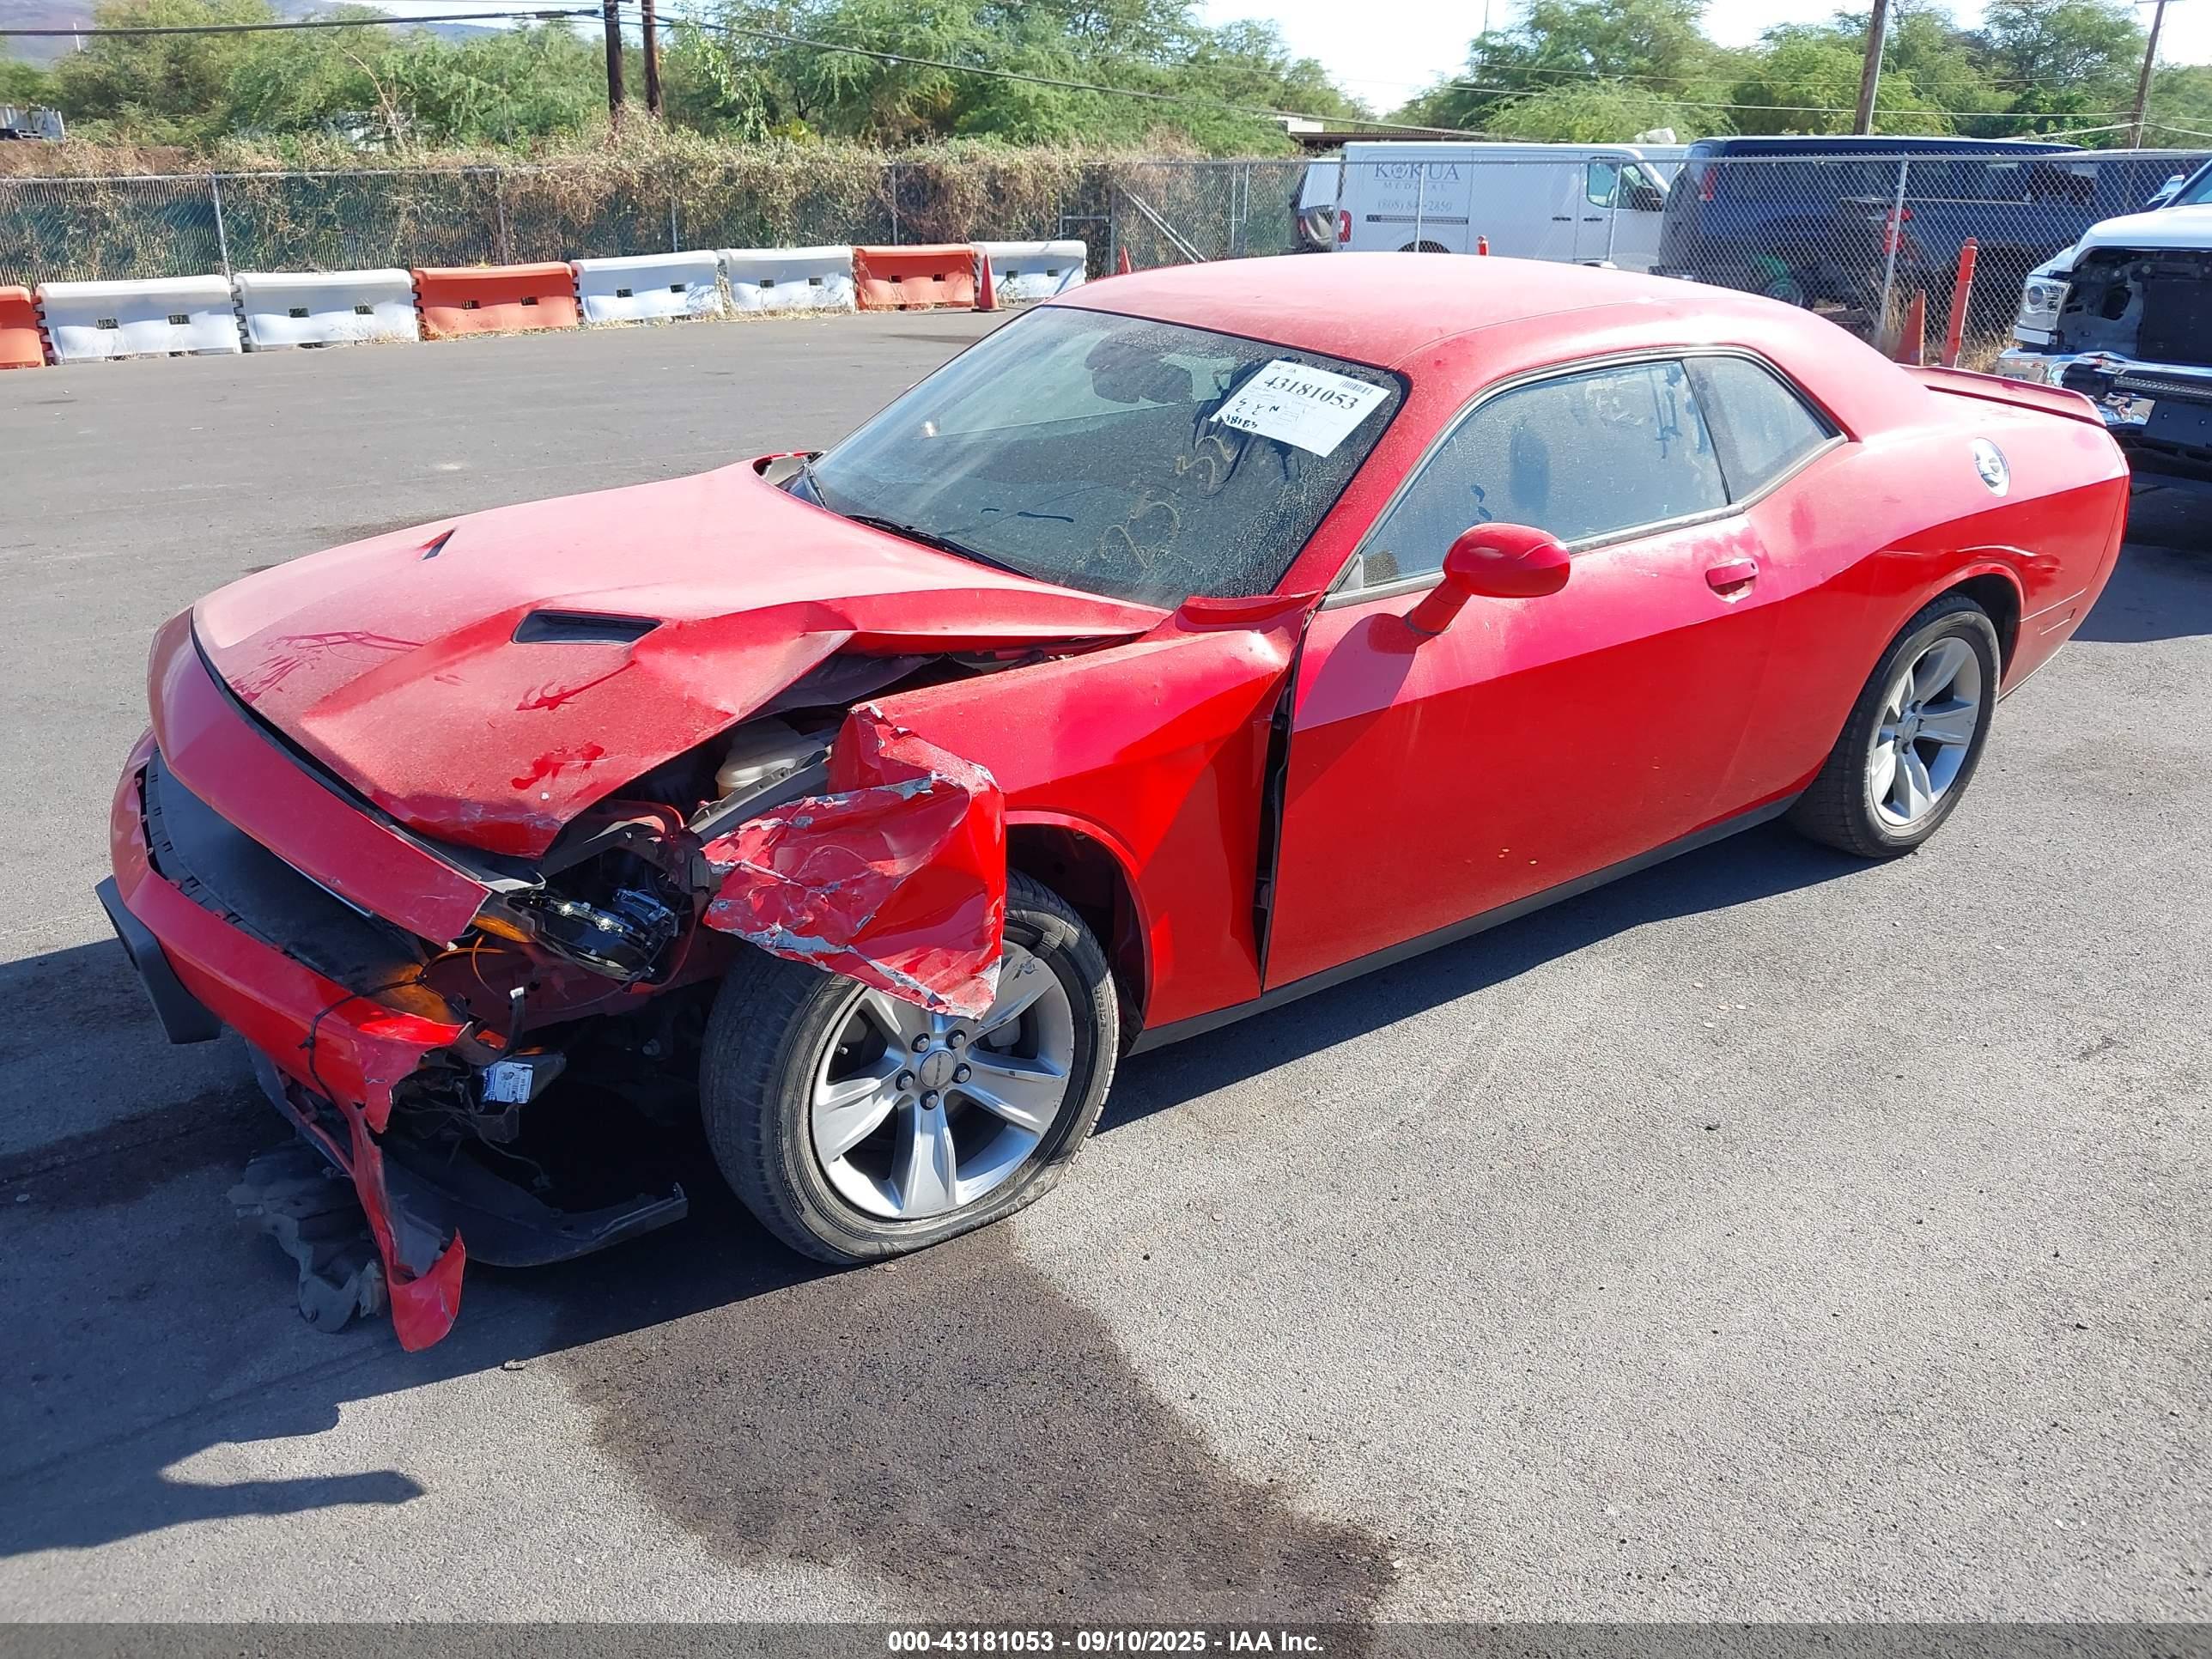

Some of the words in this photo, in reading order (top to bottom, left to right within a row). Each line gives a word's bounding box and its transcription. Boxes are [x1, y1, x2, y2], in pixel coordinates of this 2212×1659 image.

[1376, 162, 1460, 180] KOKUA
[1384, 181, 1447, 192] MEDIAL
[1264, 376, 1358, 410] 43181053
